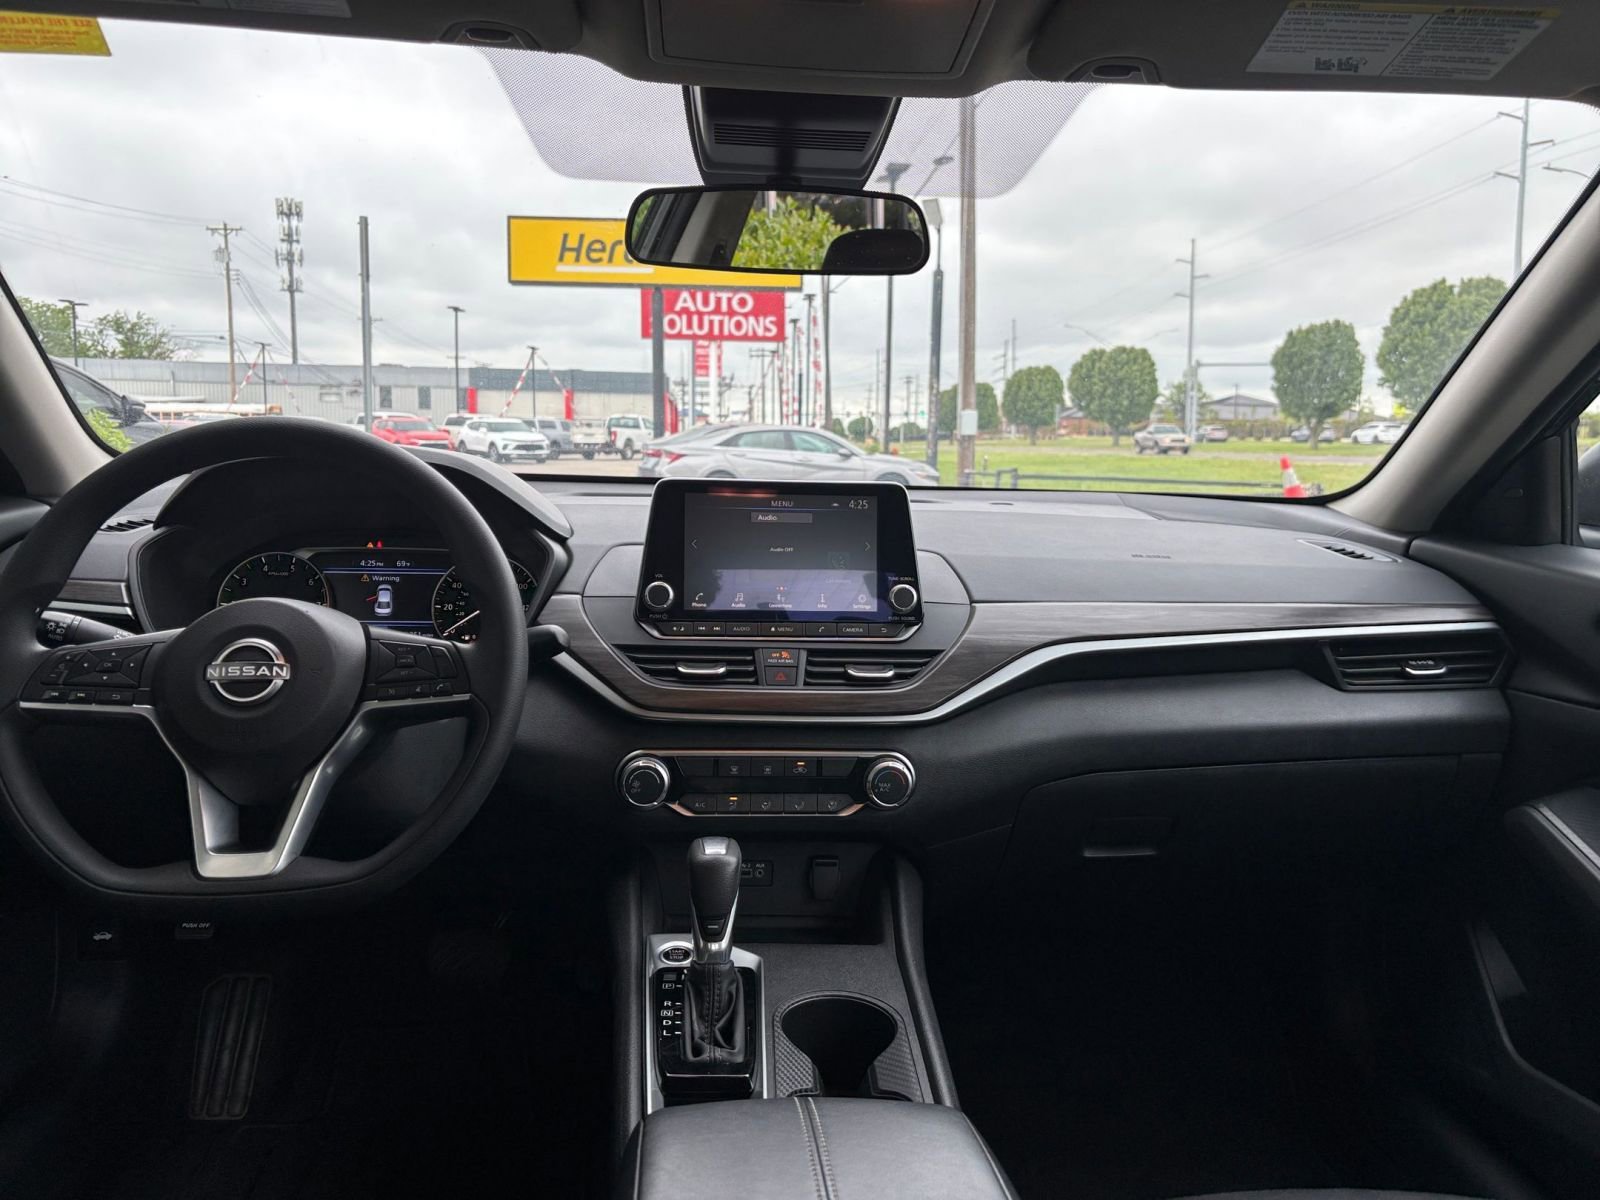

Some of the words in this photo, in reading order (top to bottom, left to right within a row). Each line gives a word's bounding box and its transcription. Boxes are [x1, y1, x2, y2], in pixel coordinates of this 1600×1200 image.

[558, 233, 634, 264] Her
[674, 291, 754, 313] AUTO
[649, 313, 778, 337] OLUTIONS
[848, 500, 869, 509] 4:25
[371, 575, 400, 583] Warning
[206, 665, 288, 678] NISSAN
